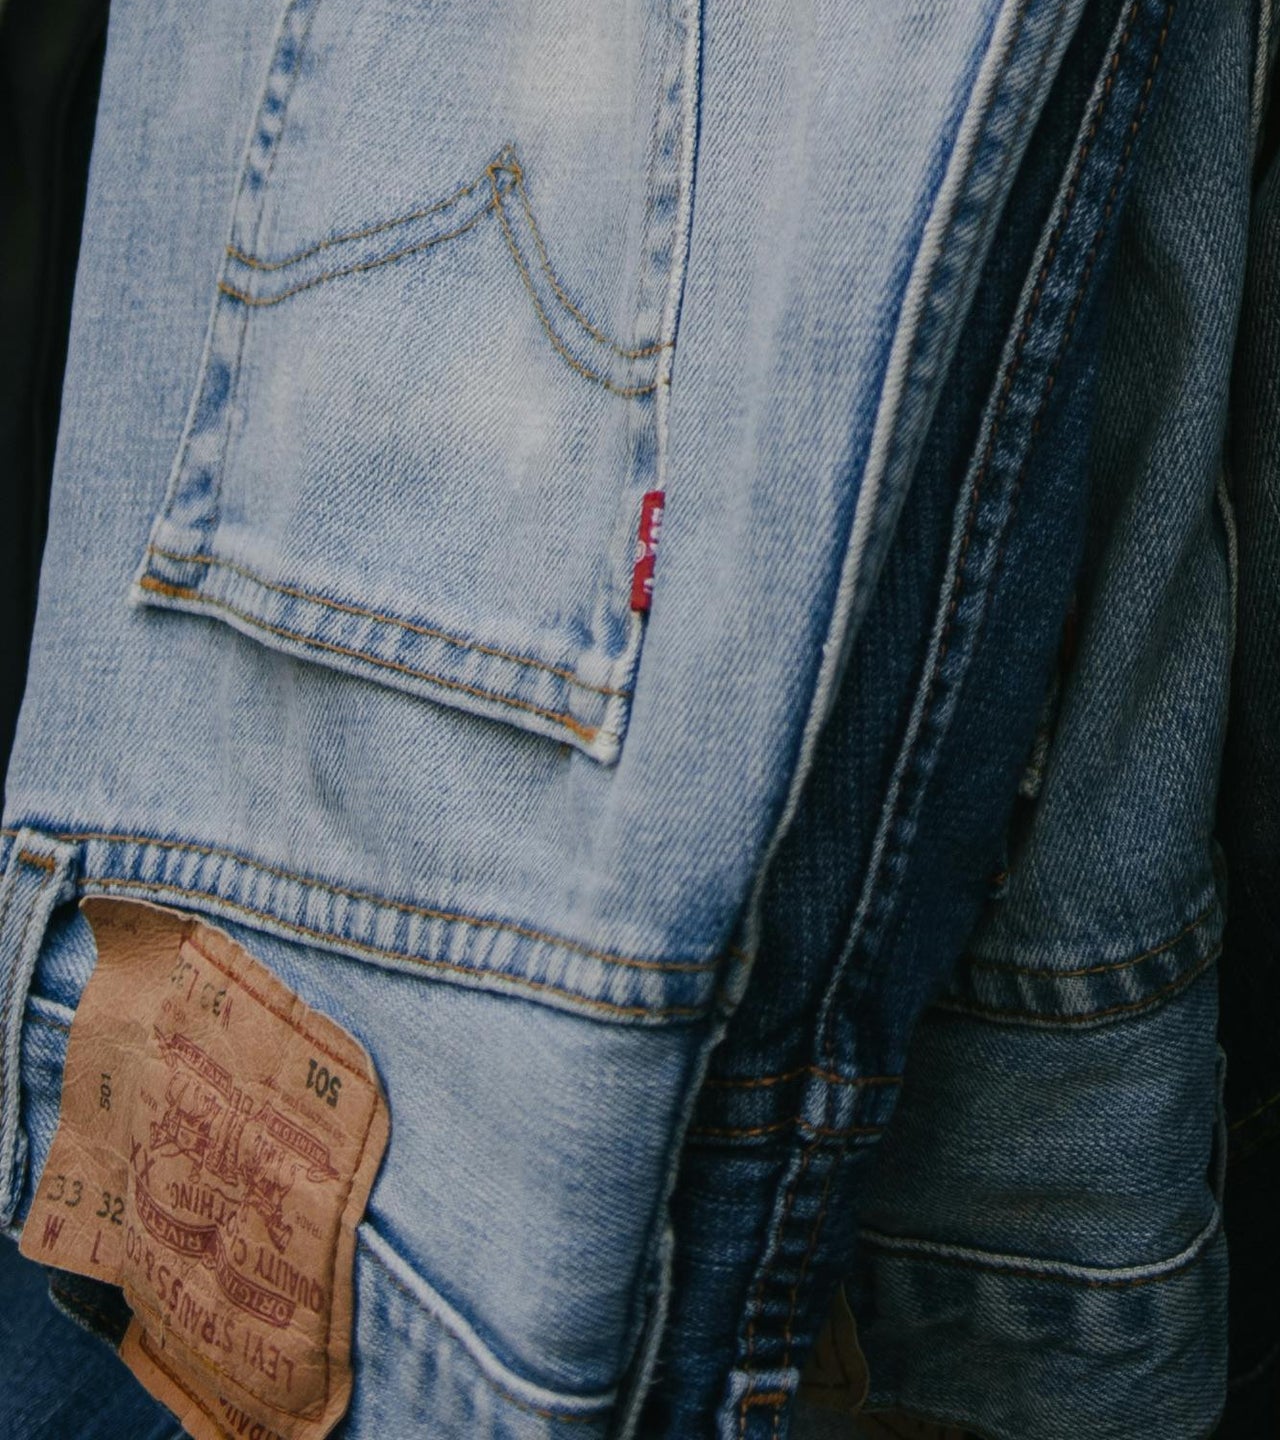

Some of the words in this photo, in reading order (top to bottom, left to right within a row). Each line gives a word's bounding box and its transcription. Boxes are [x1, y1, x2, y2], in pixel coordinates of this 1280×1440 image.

[186, 969, 199, 1002] L
[100, 1072, 111, 1112] 501
[306, 1059, 341, 1109] 501
[47, 1175, 83, 1207] 33
[96, 1191, 125, 1225] 32
[42, 1215, 65, 1251] W
[90, 1229, 102, 1265] L
[254, 1247, 323, 1314] QUALITY
[243, 1330, 294, 1392] LEVI
